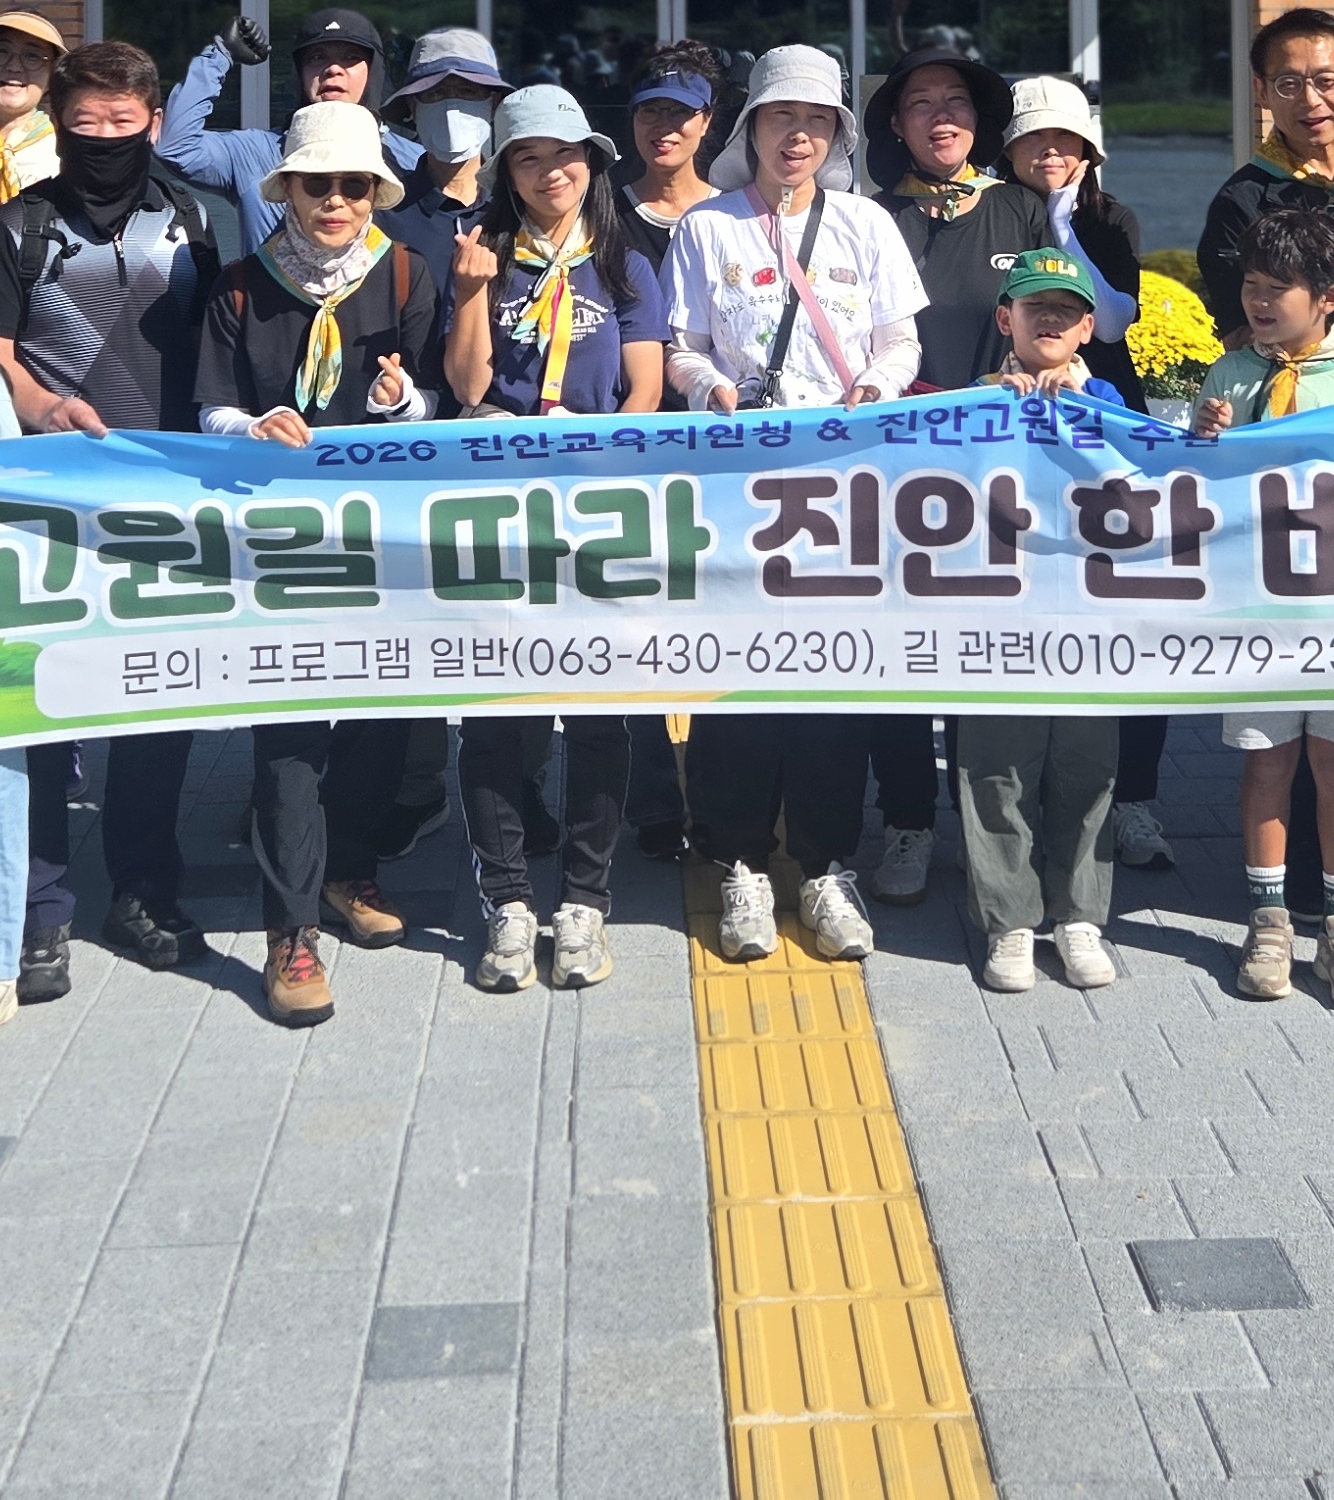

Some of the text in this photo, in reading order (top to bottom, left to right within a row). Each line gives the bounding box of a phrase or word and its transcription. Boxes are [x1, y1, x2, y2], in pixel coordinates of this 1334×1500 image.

[316, 438, 437, 466] 2026
[461, 421, 793, 463] 진안교육지원청
[817, 417, 850, 440] &
[876, 399, 1106, 449] 진안고원길
[430, 480, 712, 604] 따라
[752, 472, 1032, 600] 진안
[1071, 472, 1212, 600] 한
[120, 648, 203, 697] 문의
[220, 655, 230, 685] :
[247, 635, 414, 687] 프로그램
[430, 627, 887, 683] 일반(063-430-6230),
[903, 627, 942, 676] 길
